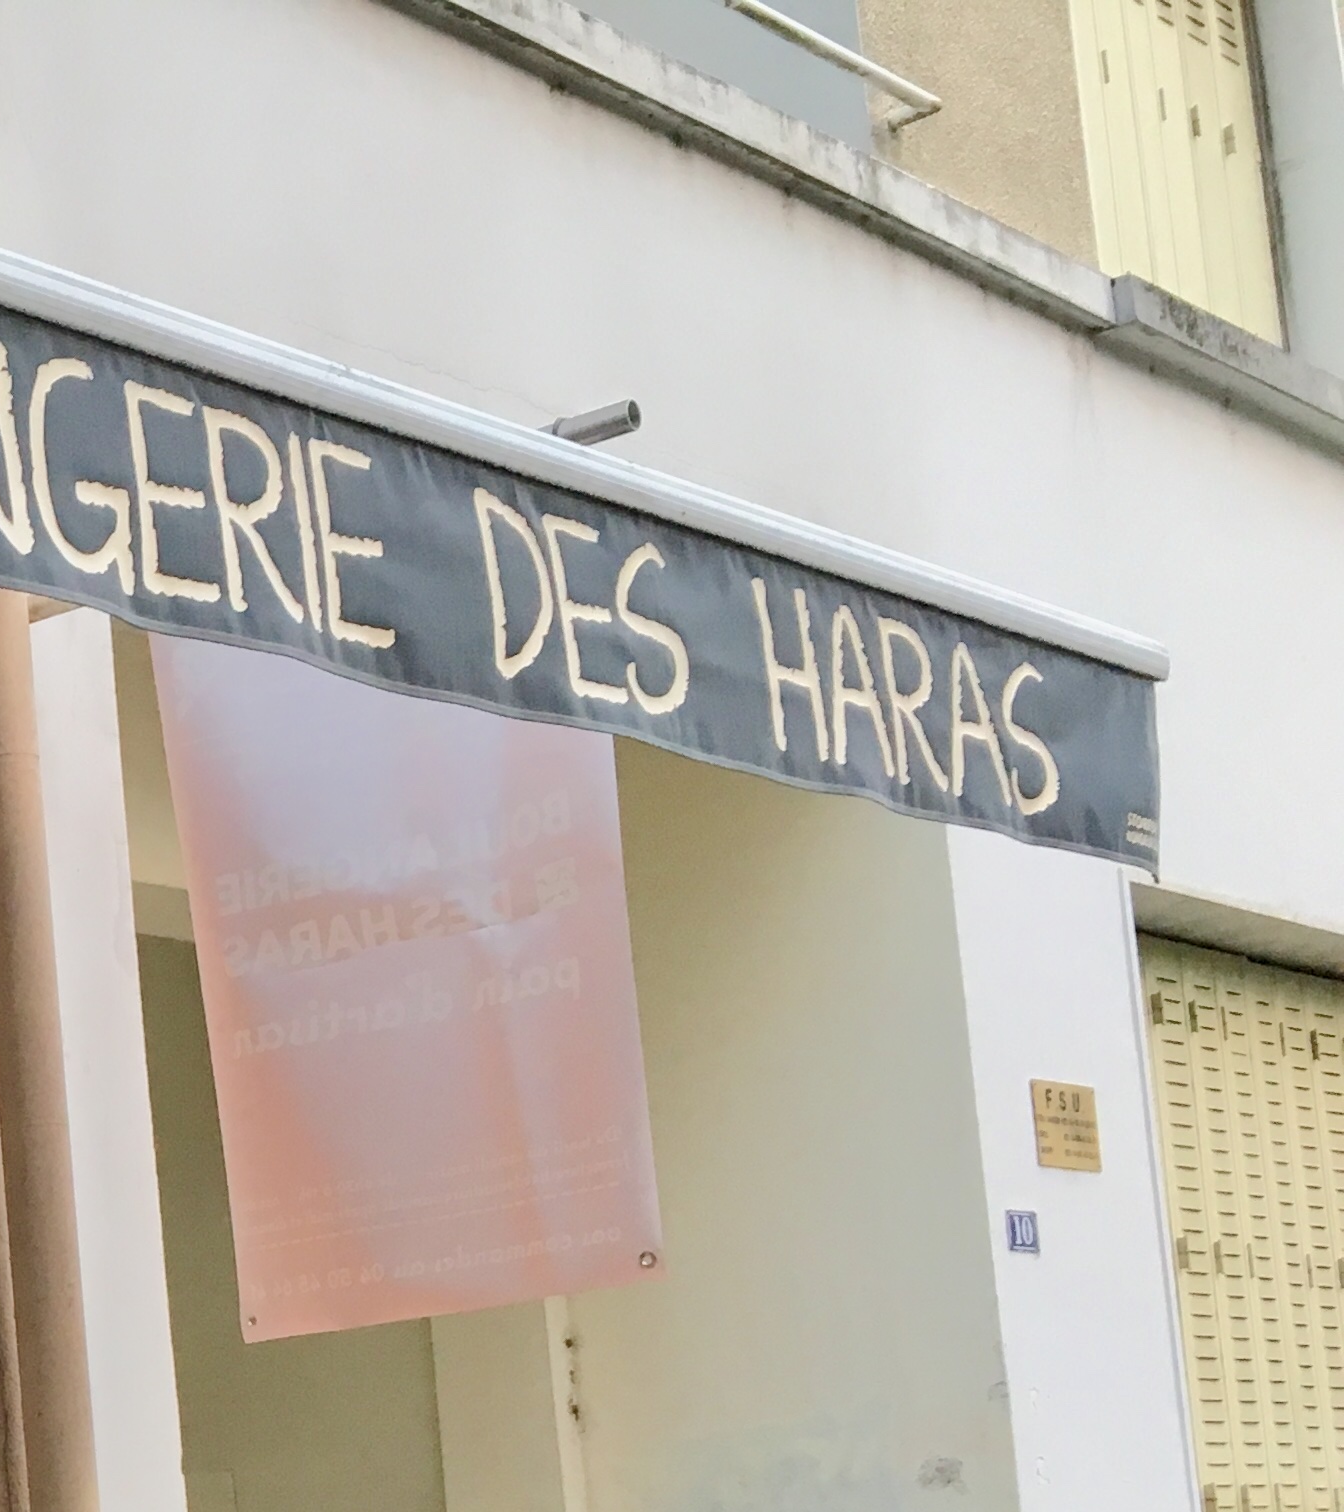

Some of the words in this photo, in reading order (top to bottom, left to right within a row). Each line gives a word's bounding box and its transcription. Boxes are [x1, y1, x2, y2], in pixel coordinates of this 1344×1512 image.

[472, 487, 690, 715] DES
[750, 577, 1061, 816] HARAS
[1012, 1215, 1034, 1246] 10
